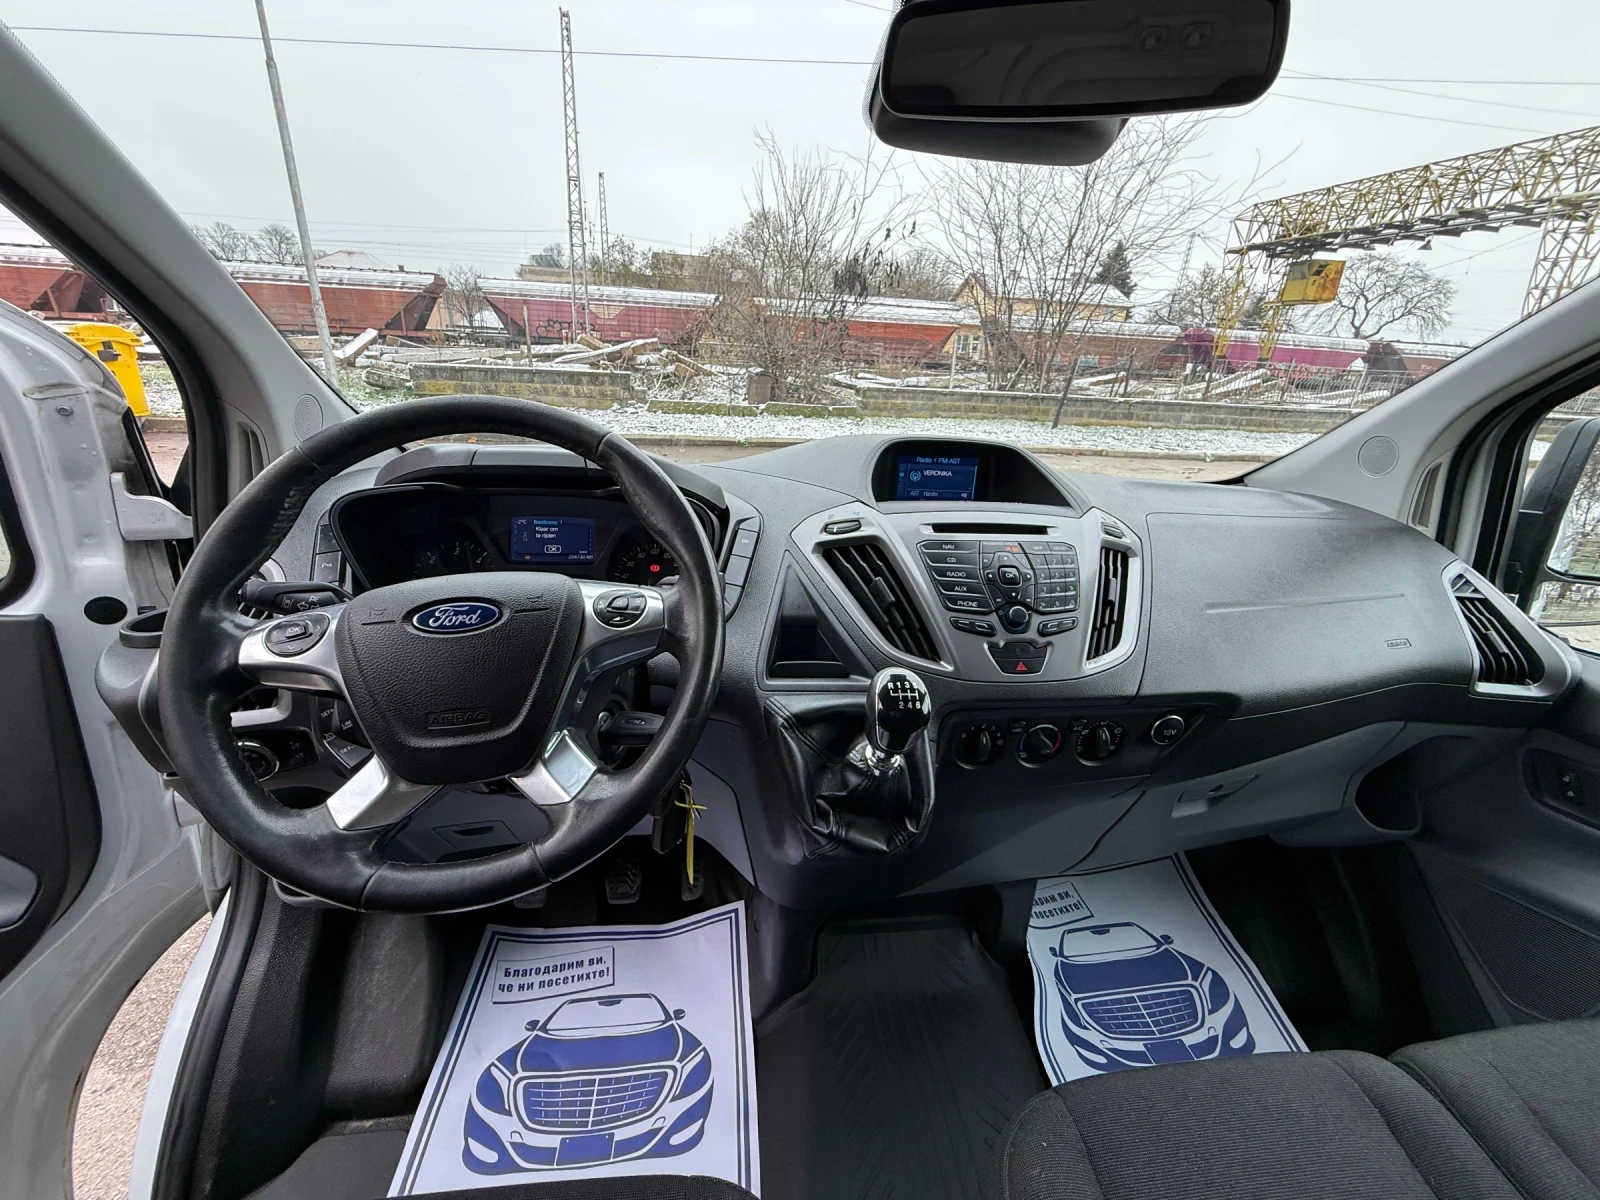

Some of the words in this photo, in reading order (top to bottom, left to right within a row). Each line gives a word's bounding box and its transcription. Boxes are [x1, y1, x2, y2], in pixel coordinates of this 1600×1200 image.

[453, 547, 461, 555] 3
[428, 556, 436, 564] 2
[428, 606, 481, 627] Ford
[904, 681, 910, 689] 3
[898, 701, 904, 709] 2
[907, 701, 913, 709] 4
[915, 701, 921, 709] 6
[430, 710, 486, 726] AIRBAG
[1057, 890, 1074, 901] ви,
[1033, 900, 1084, 919] посетихте!
[503, 960, 584, 978] Благодарим
[588, 956, 607, 967] ви,
[498, 983, 514, 993] че
[517, 981, 534, 992] ни
[538, 966, 610, 990] посетихте!
